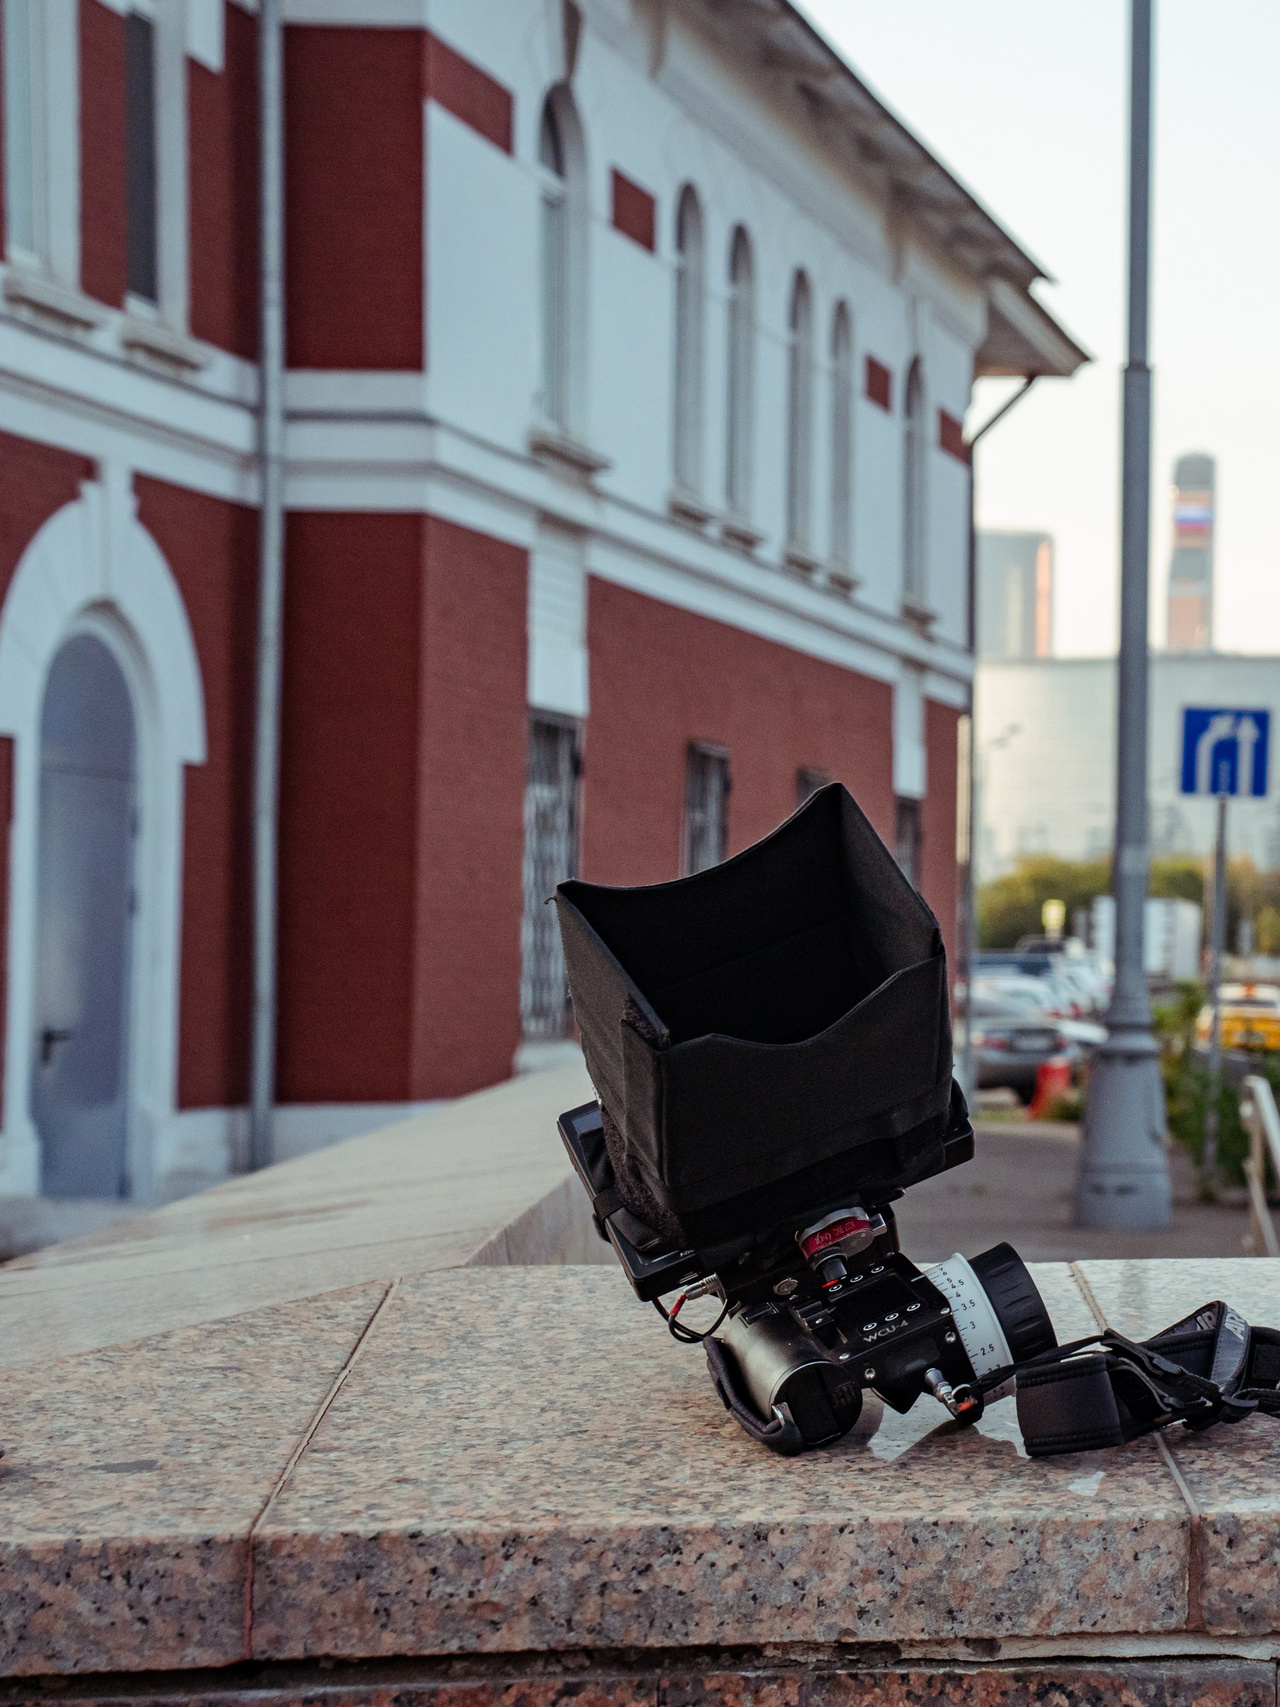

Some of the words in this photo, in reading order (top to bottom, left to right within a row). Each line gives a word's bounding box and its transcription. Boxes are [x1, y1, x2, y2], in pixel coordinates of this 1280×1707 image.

[951, 1279, 964, 1289] 4.5
[961, 1299, 976, 1311] 3.5
[863, 1320, 908, 1343] WCU-4
[969, 1321, 976, 1330] 3
[980, 1343, 996, 1356] 2.5
